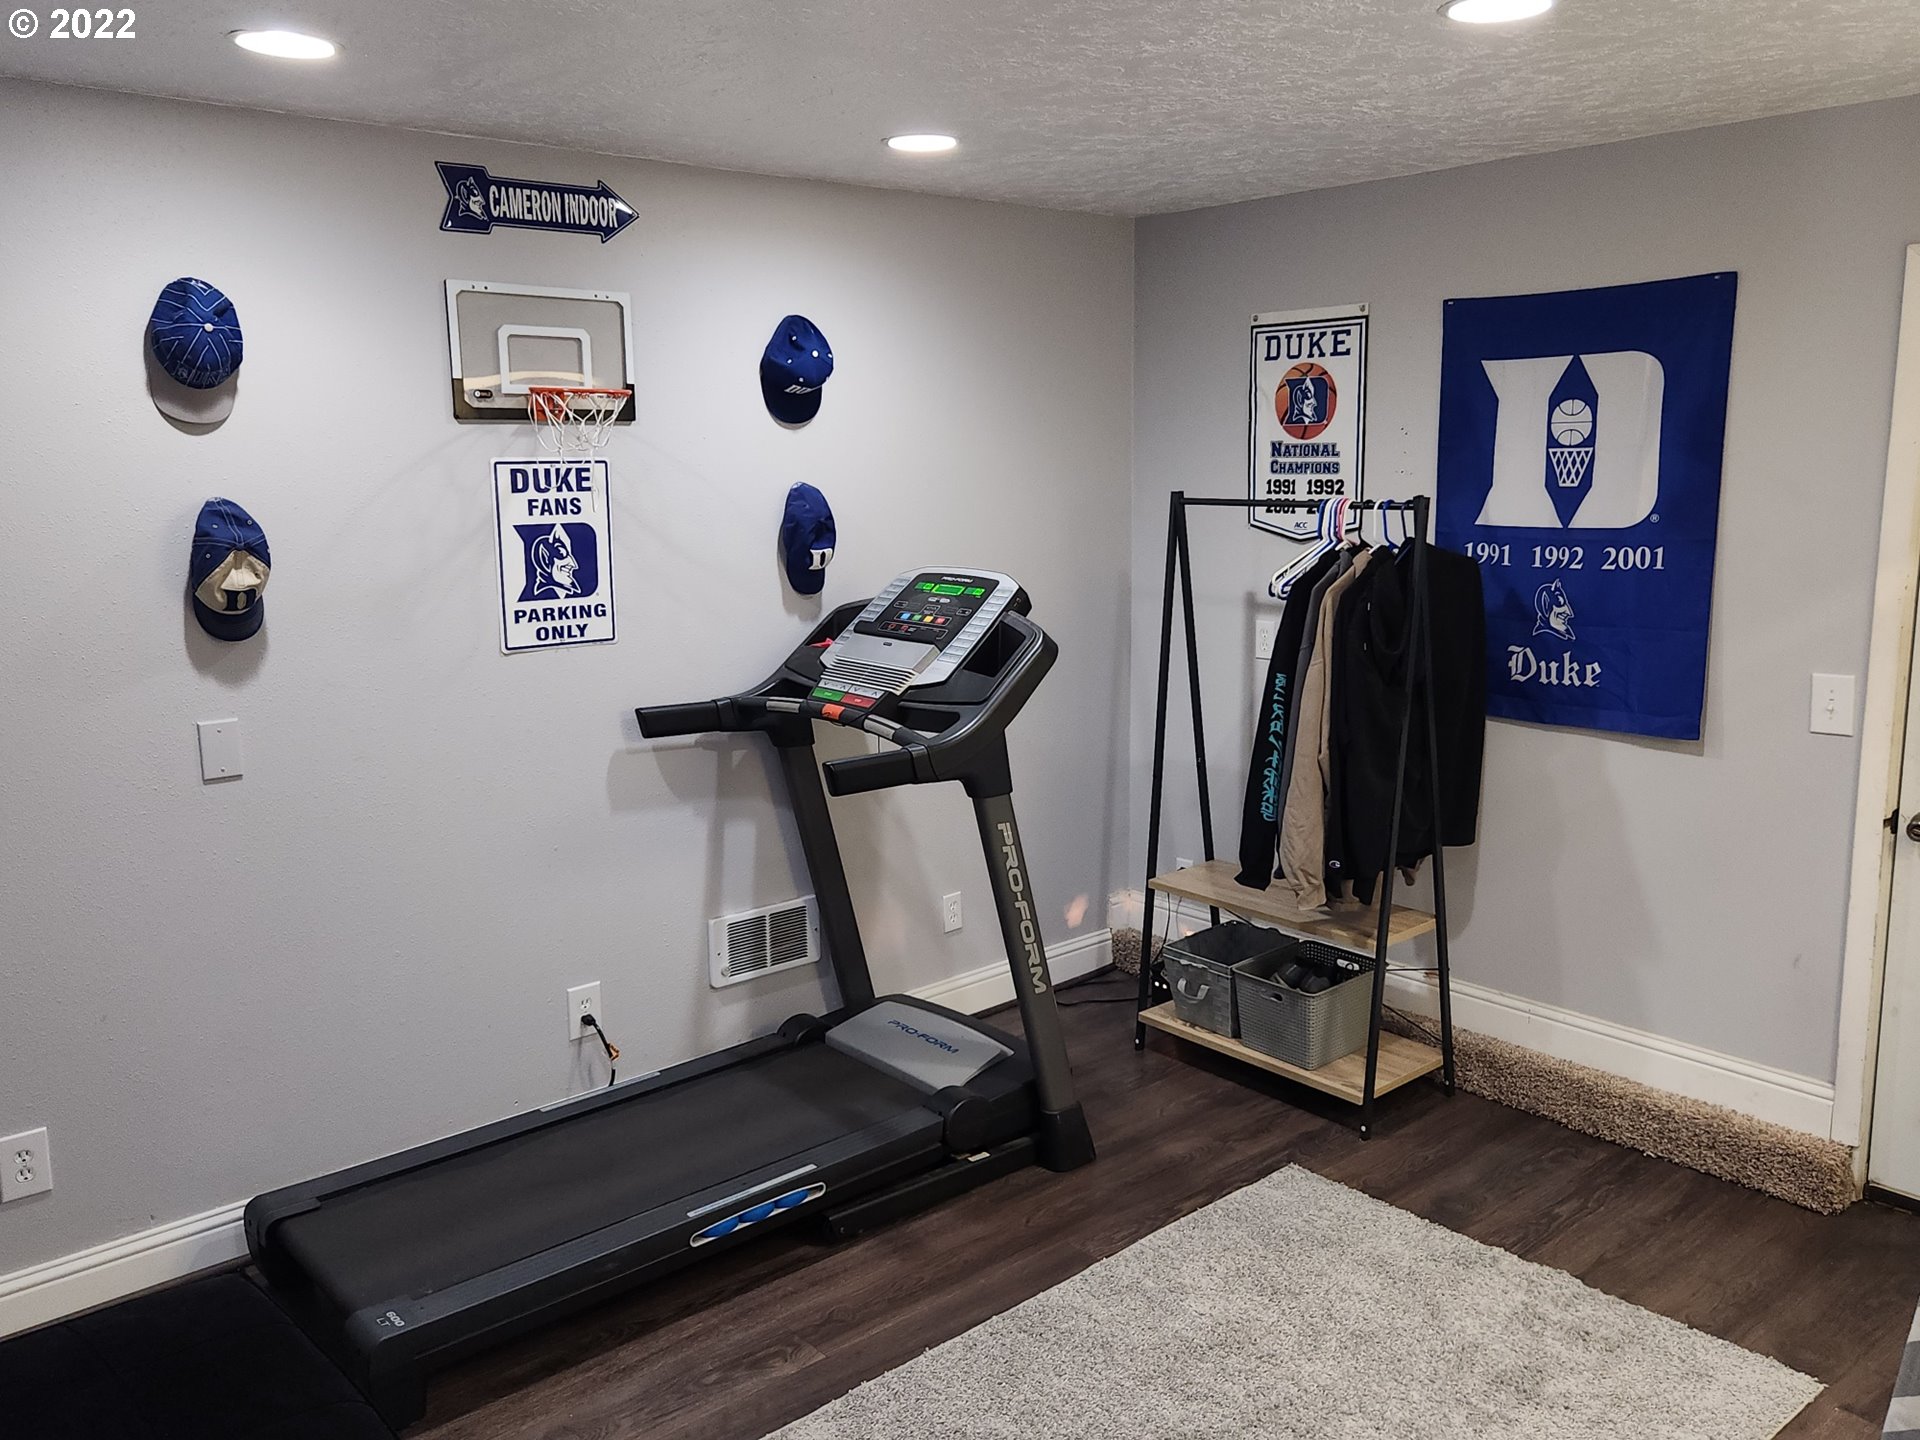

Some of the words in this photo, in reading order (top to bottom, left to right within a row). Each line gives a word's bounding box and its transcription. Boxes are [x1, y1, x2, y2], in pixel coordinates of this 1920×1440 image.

[489, 185, 562, 223] CAMERON
[564, 193, 618, 228] INDOOR
[1264, 329, 1352, 361] DUKE
[1270, 441, 1341, 458] NATIONAL
[1270, 459, 1341, 475] CHAMPIONS
[510, 467, 592, 493] DUKE
[1266, 478, 1296, 495] 1991
[1306, 478, 1345, 496] 1992
[527, 497, 582, 516] FANS
[1294, 521, 1309, 530] ACC
[1464, 542, 1512, 566] 1991
[1531, 545, 1584, 570] 1992
[1600, 546, 1665, 570] 2001
[513, 603, 607, 625] PARKING
[535, 623, 589, 642] ONLY
[1507, 645, 1602, 687] Duke
[997, 822, 1047, 994] PRO-FORM
[887, 1019, 960, 1054] PRO-FORM
[376, 1317, 391, 1326] LT
[386, 1311, 405, 1327] 600
